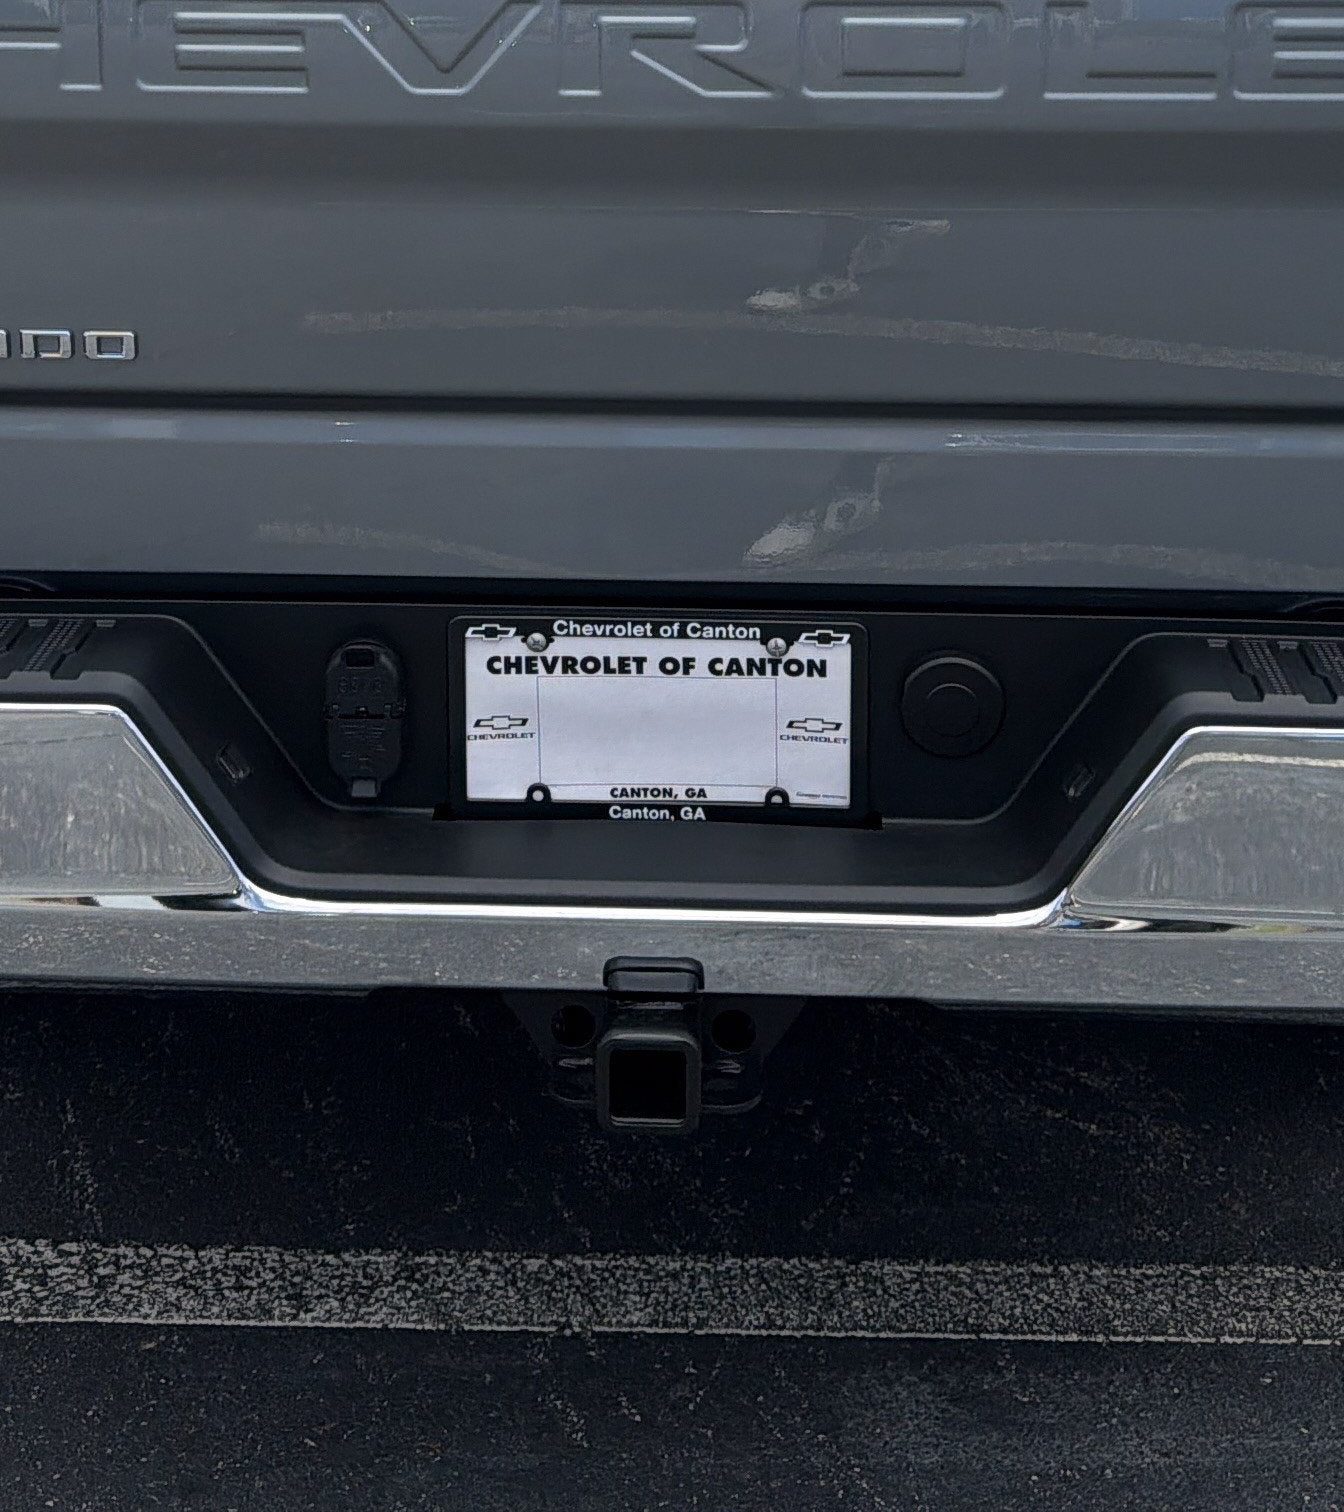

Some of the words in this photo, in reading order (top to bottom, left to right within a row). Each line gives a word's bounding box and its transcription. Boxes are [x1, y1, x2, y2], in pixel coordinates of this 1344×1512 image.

[552, 619, 654, 639] Chevrolet
[659, 621, 682, 639] of
[686, 621, 762, 640] Canton
[486, 655, 647, 676] CHEVROLET
[658, 656, 696, 676] OF
[708, 657, 828, 678] CANTON
[467, 731, 536, 741] CHEVROLET
[779, 734, 849, 745] CHEVROLET
[609, 786, 679, 800] CANTON,
[685, 787, 709, 799] GA
[608, 806, 676, 822] Canton,
[680, 807, 707, 821] GA
